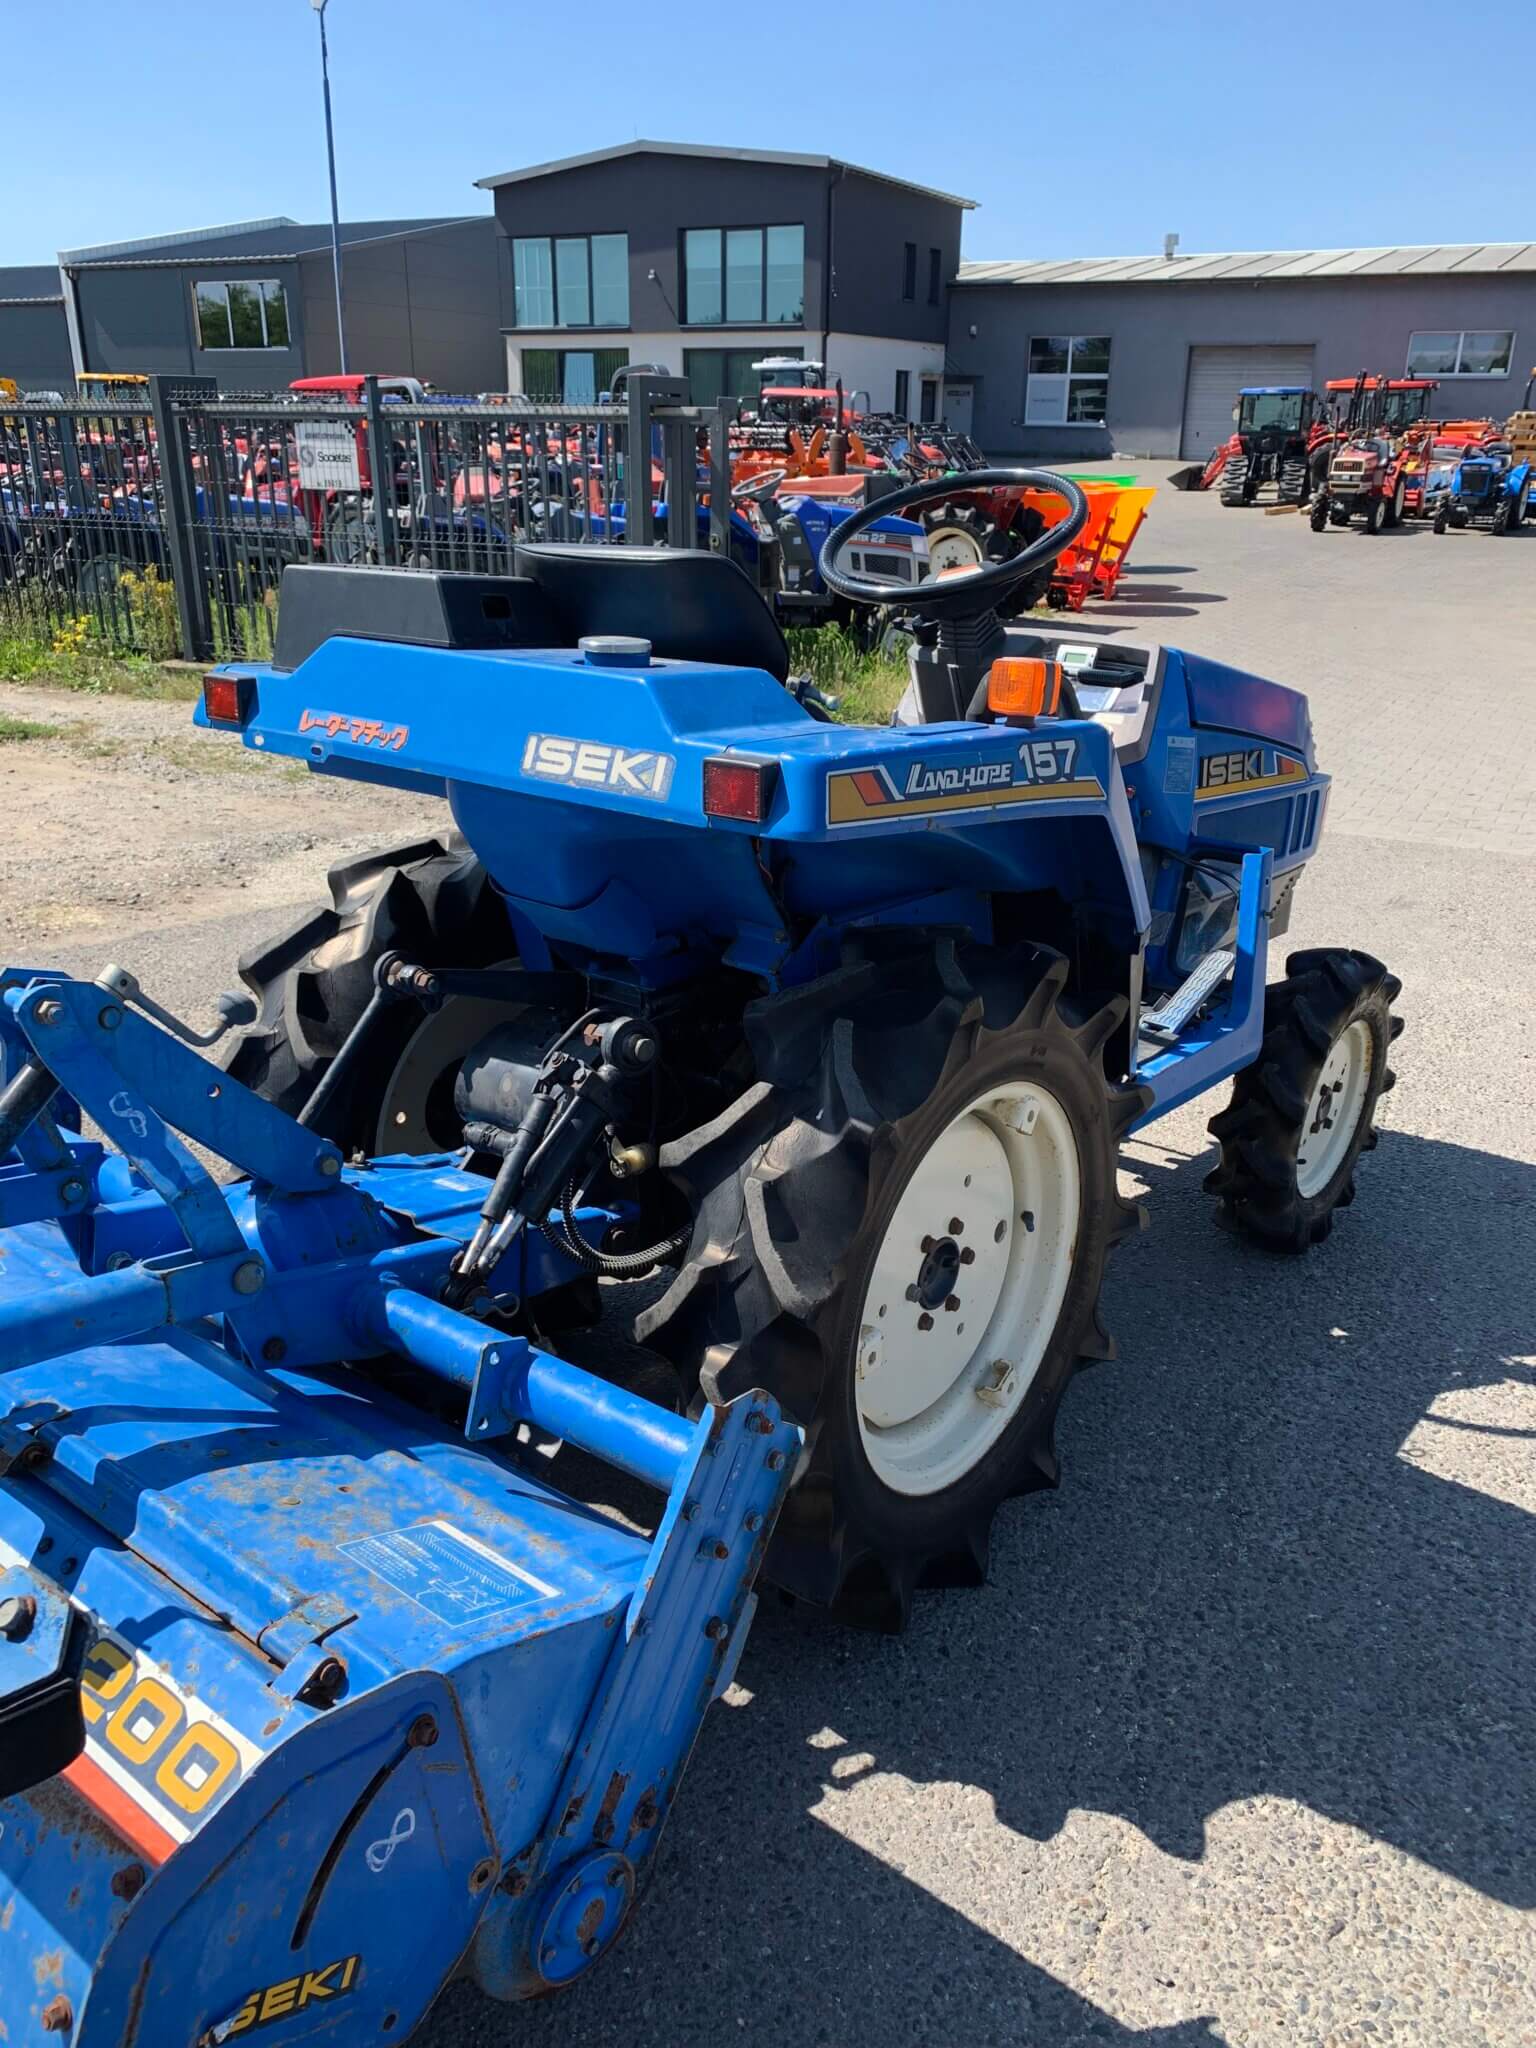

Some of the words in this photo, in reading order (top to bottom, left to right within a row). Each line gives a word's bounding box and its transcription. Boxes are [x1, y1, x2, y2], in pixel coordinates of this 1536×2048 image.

[317, 451, 352, 463] Societas
[299, 709, 409, 751] レーダーマチック
[522, 735, 668, 793] ISEKI
[1018, 739, 1076, 779] 157
[1201, 749, 1265, 788] ISEKI
[198, 1955, 359, 2047] SEKI
